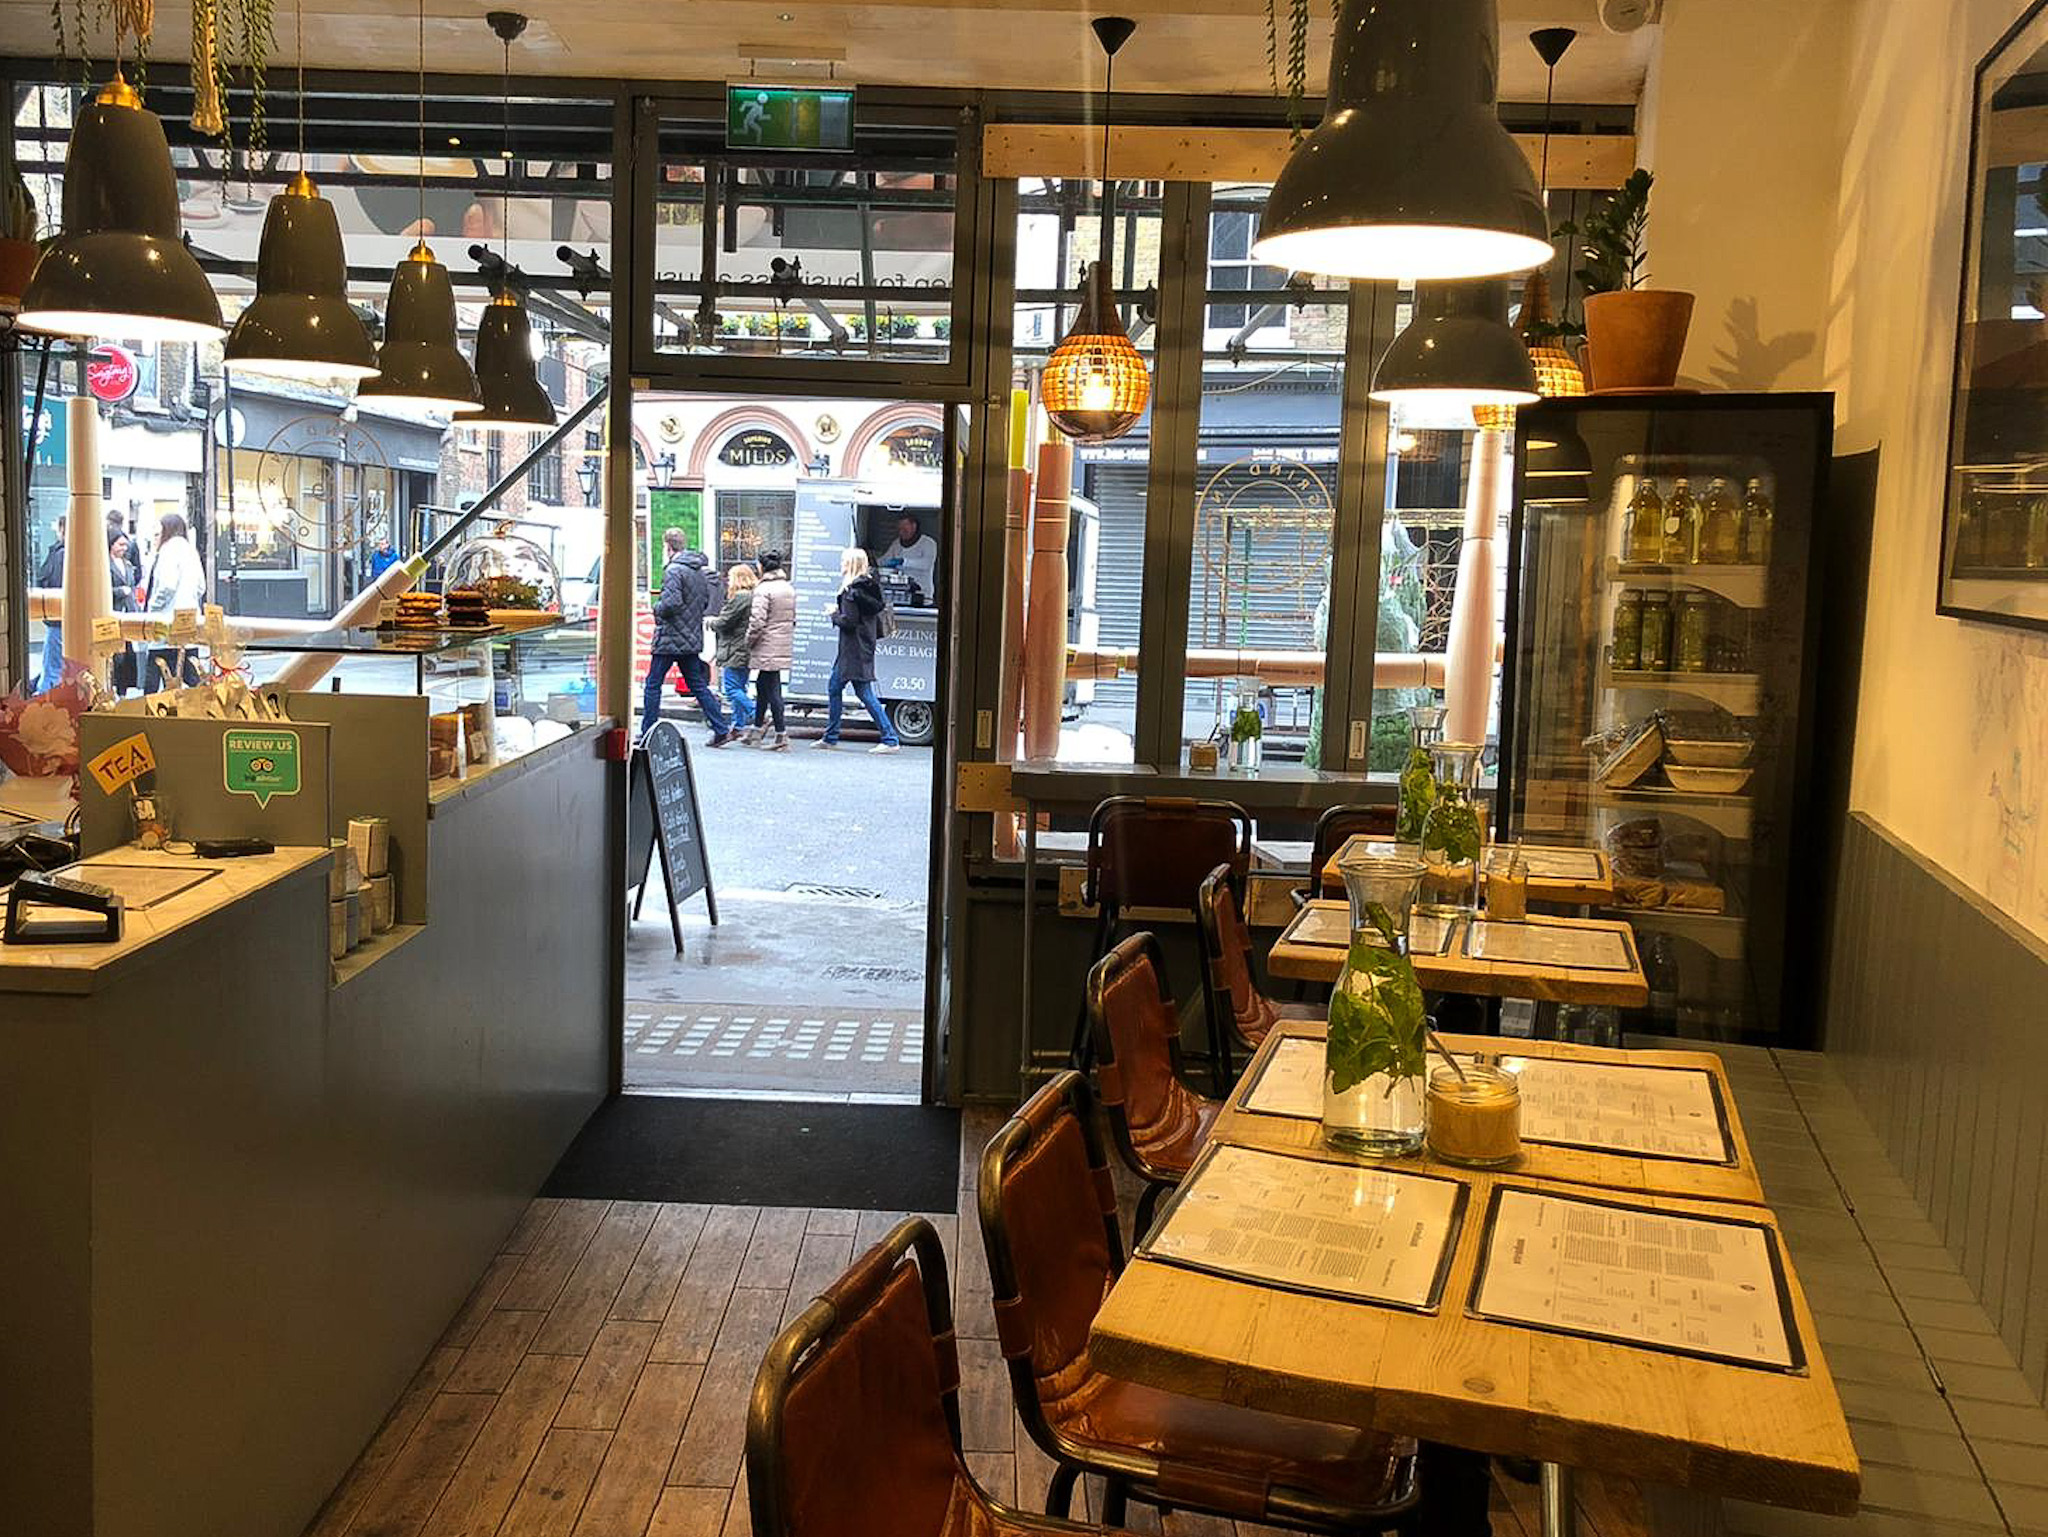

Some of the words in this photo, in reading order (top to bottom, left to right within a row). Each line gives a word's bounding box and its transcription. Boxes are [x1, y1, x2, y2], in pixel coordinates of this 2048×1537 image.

[730, 449, 787, 465] MILDS
[890, 676, 926, 692] £3.50
[229, 739, 274, 751] REVIEW
[277, 740, 293, 751] US
[98, 745, 147, 780] TEA
